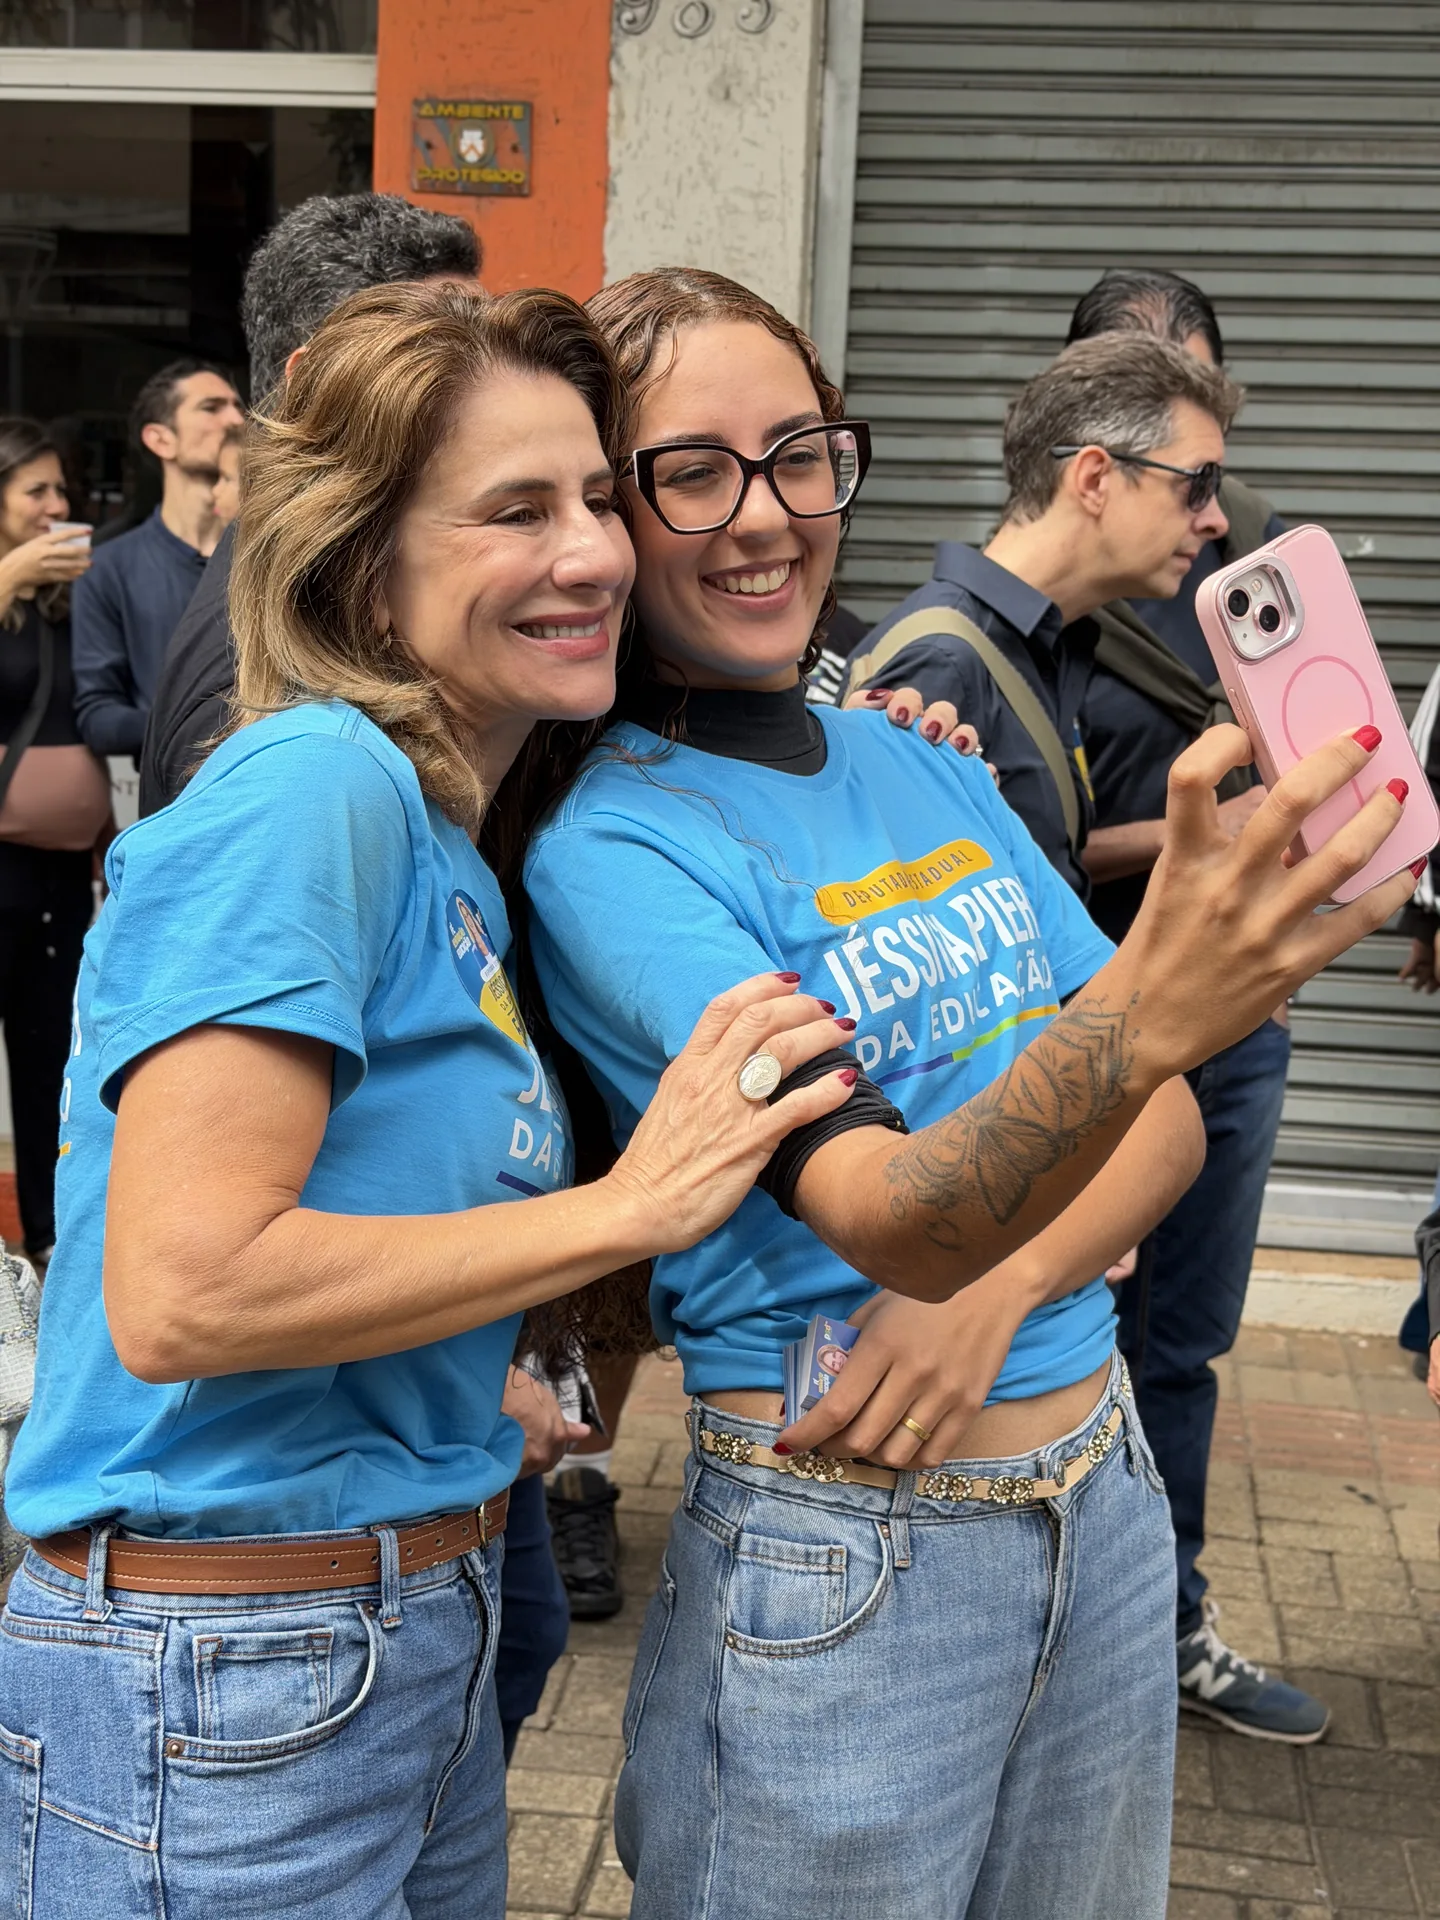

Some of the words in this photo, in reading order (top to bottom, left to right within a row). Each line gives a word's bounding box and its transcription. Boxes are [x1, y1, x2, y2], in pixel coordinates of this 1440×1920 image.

[419, 102, 525, 119] AMBIENTE
[417, 168, 526, 184] PROTEGIDO
[855, 1019, 916, 1072] DA
